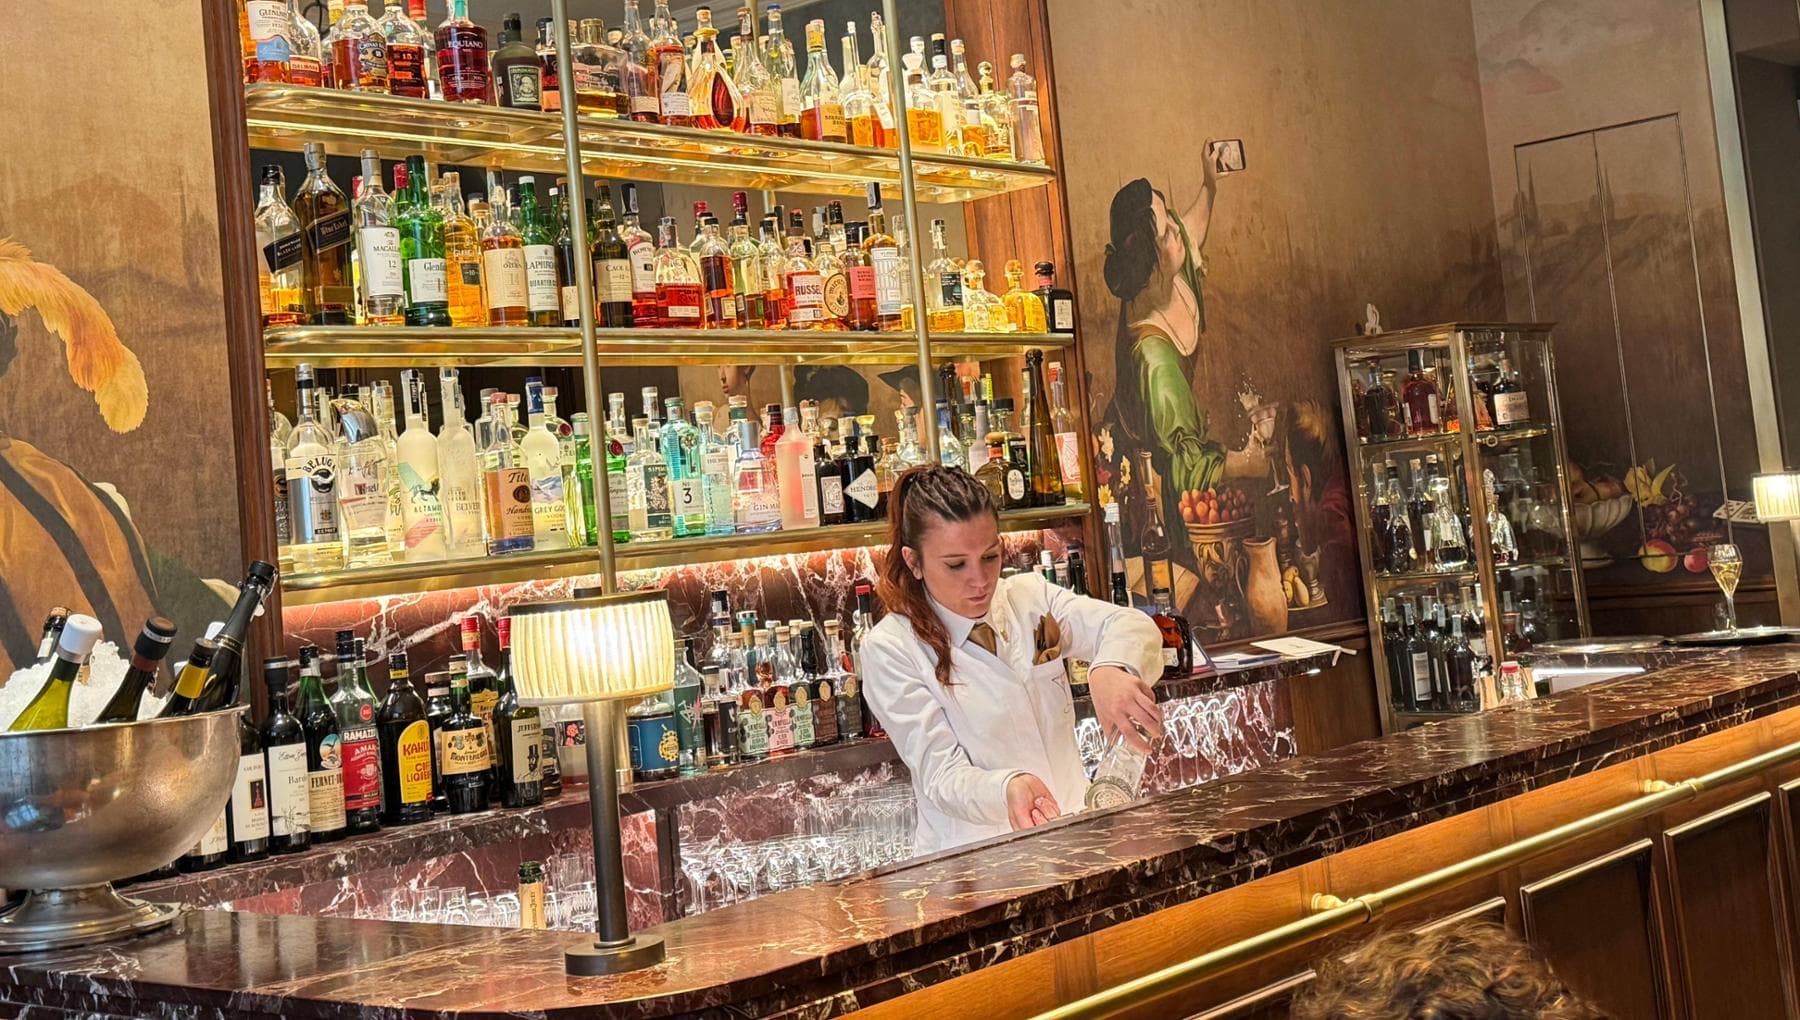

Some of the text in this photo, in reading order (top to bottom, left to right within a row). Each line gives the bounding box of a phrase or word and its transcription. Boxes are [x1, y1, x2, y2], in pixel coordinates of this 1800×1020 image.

[388, 260, 397, 268] 12
[682, 487, 693, 504] 3
[753, 503, 769, 511] GIN
